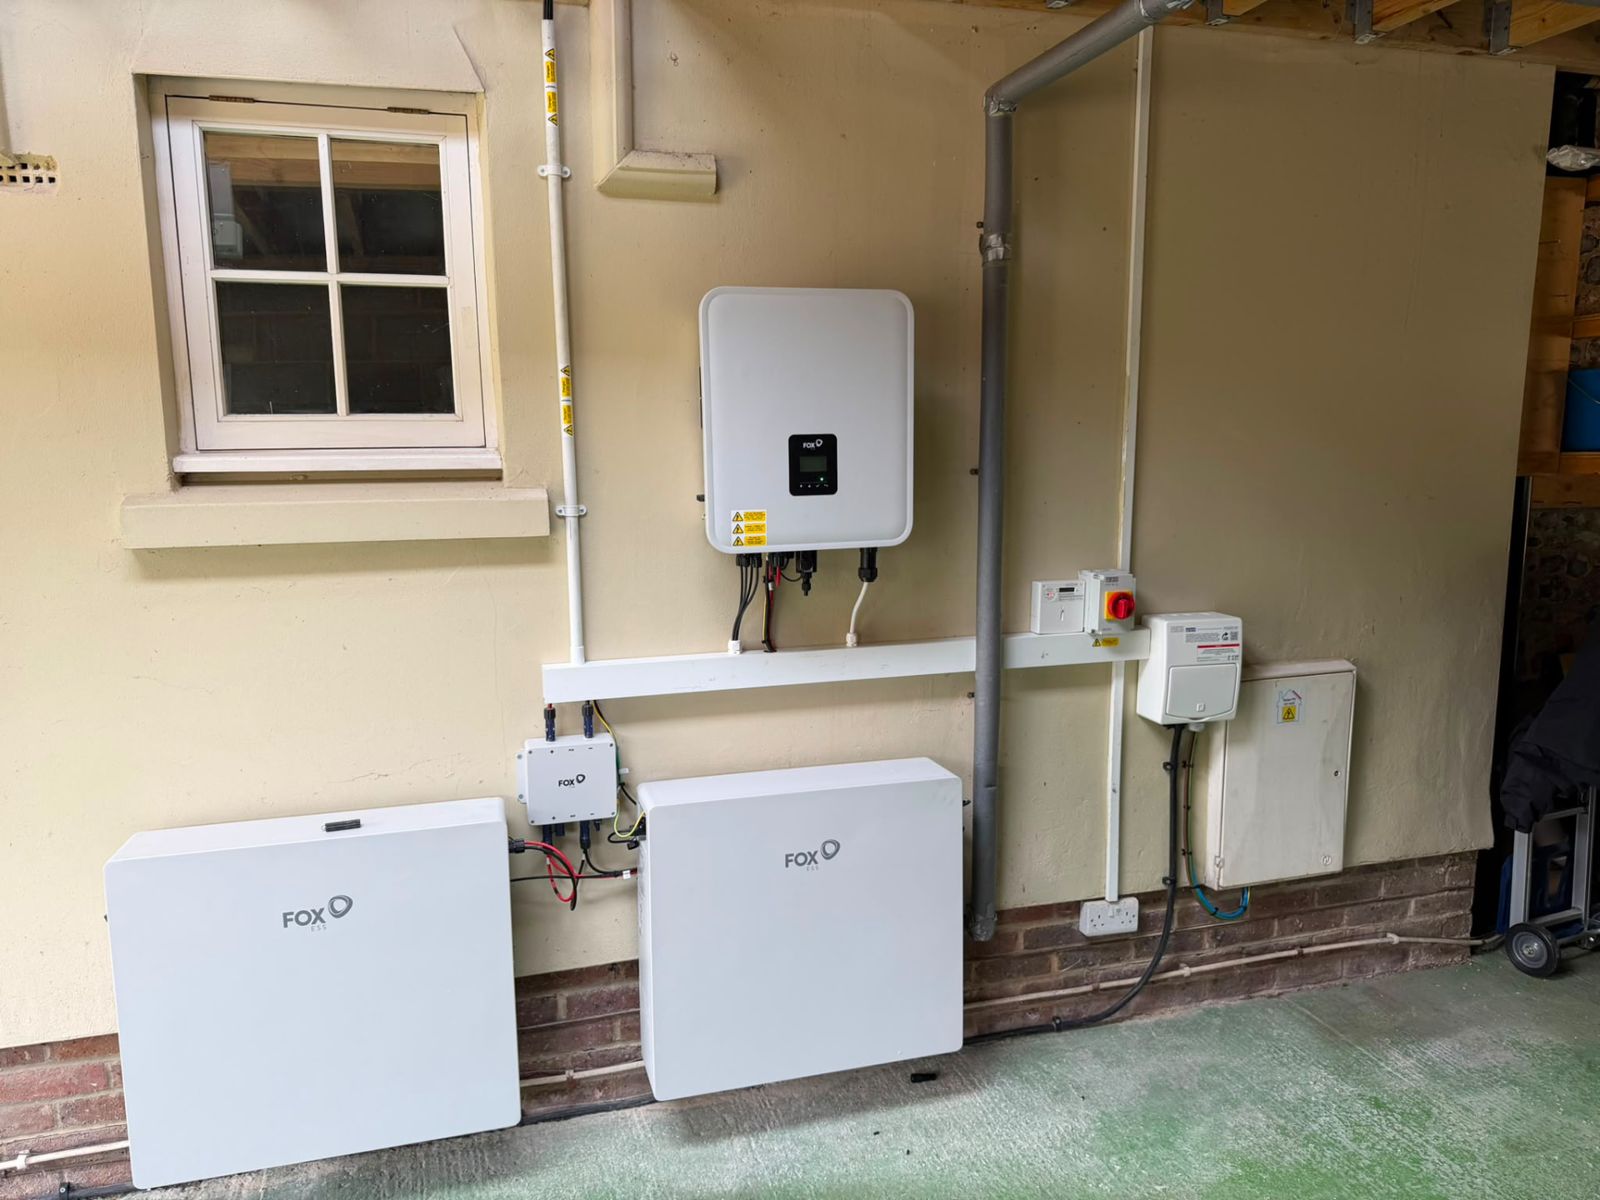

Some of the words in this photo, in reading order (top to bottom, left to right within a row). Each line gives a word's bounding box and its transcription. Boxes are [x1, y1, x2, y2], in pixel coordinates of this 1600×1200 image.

[558, 779, 575, 787] FOX
[785, 850, 819, 868] FOX
[282, 907, 326, 929] FOX
